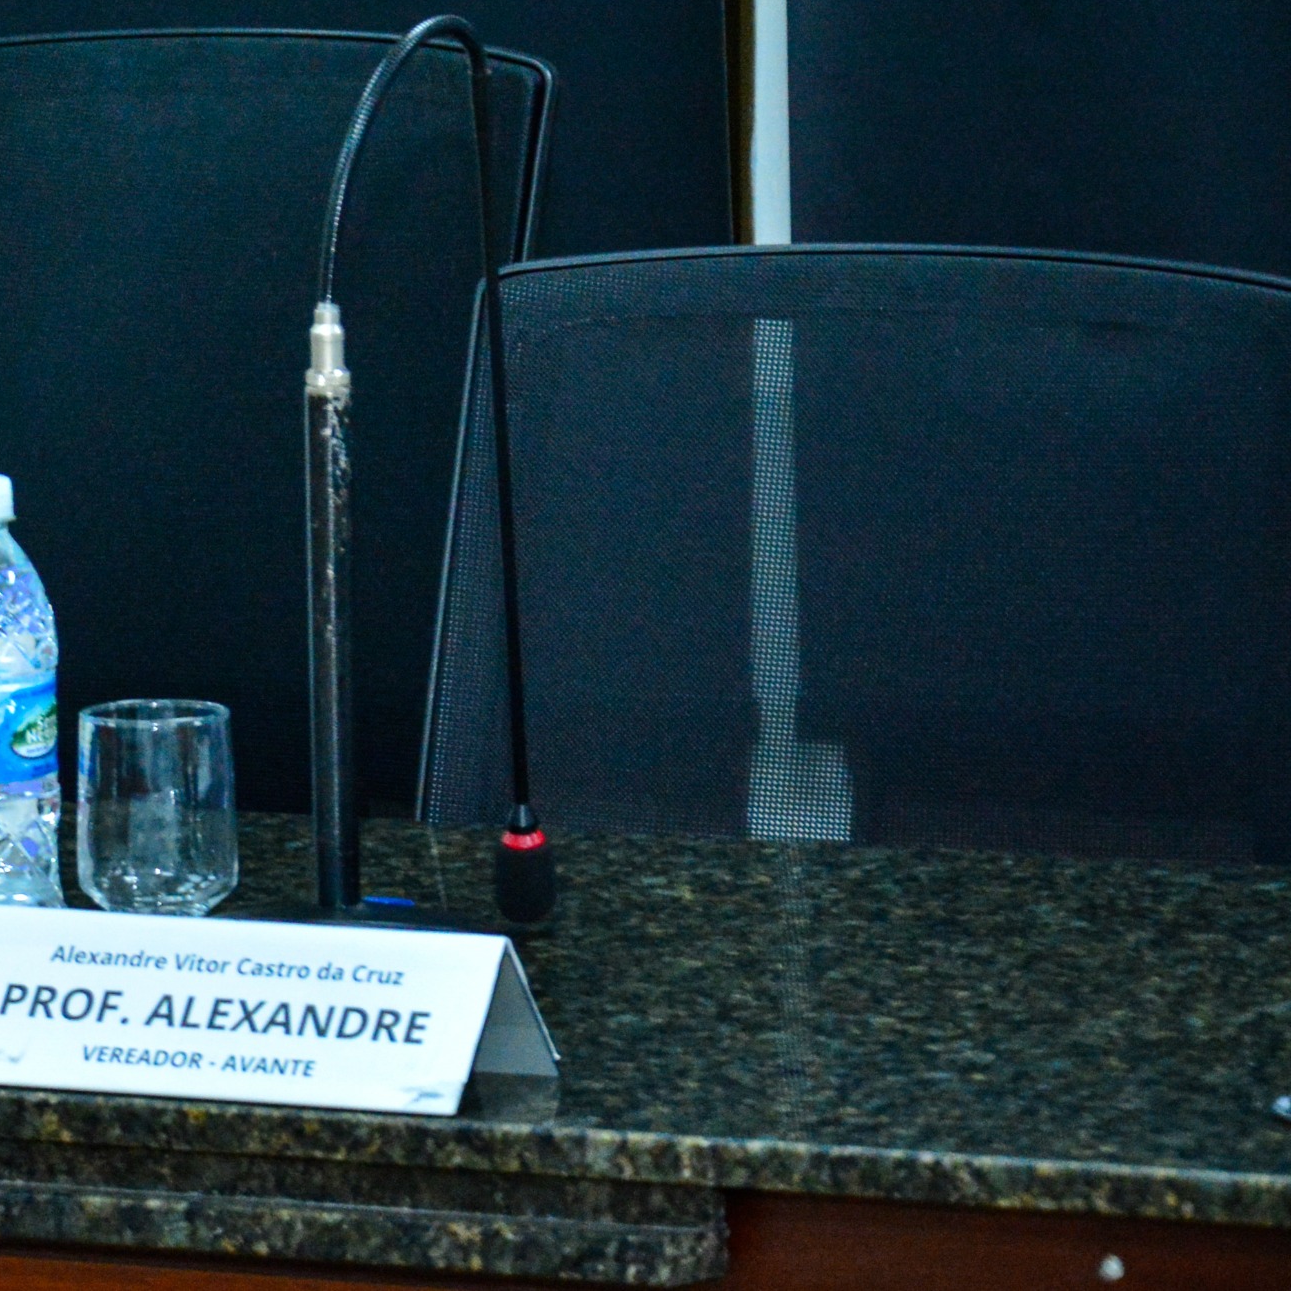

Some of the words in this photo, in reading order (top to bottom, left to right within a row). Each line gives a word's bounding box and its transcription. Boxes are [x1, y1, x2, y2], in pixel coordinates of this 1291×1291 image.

[49, 945, 168, 970] Alexandre
[174, 953, 231, 974] Vitor
[236, 958, 311, 980] Castro
[316, 962, 345, 981] da
[351, 965, 405, 986] Cruz
[143, 994, 432, 1045] ALEXANDRE
[82, 1044, 203, 1069] VEREADOR
[221, 1055, 316, 1078] AVANTE
